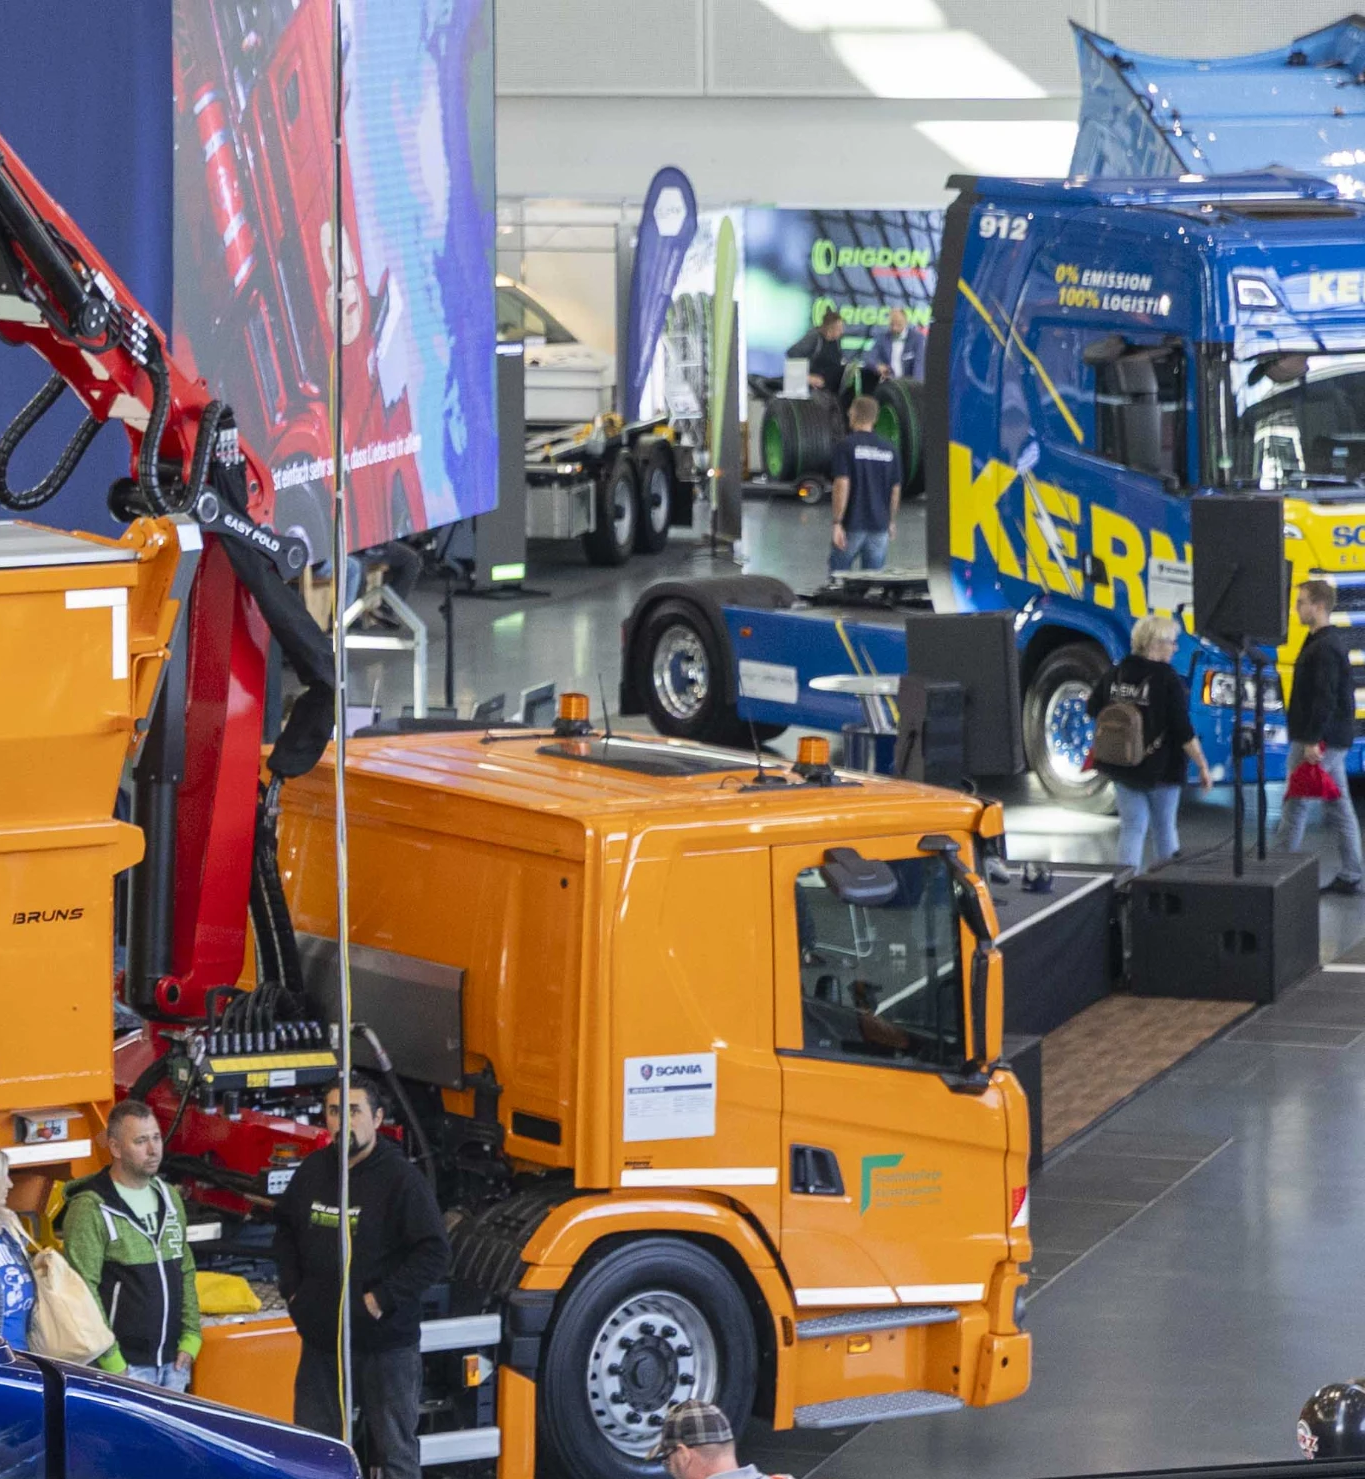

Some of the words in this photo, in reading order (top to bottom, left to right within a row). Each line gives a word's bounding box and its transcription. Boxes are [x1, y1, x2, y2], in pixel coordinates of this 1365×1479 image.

[979, 215, 1029, 241] 912
[837, 248, 930, 269] RIGDON
[1054, 263, 1080, 285] 0%
[1081, 269, 1153, 292] EMISSION
[1058, 286, 1100, 309] 100%
[224, 515, 251, 540] EASY
[249, 526, 281, 552] FOLD
[12, 908, 85, 926] BRUNS
[655, 1063, 703, 1078] SCANIA
